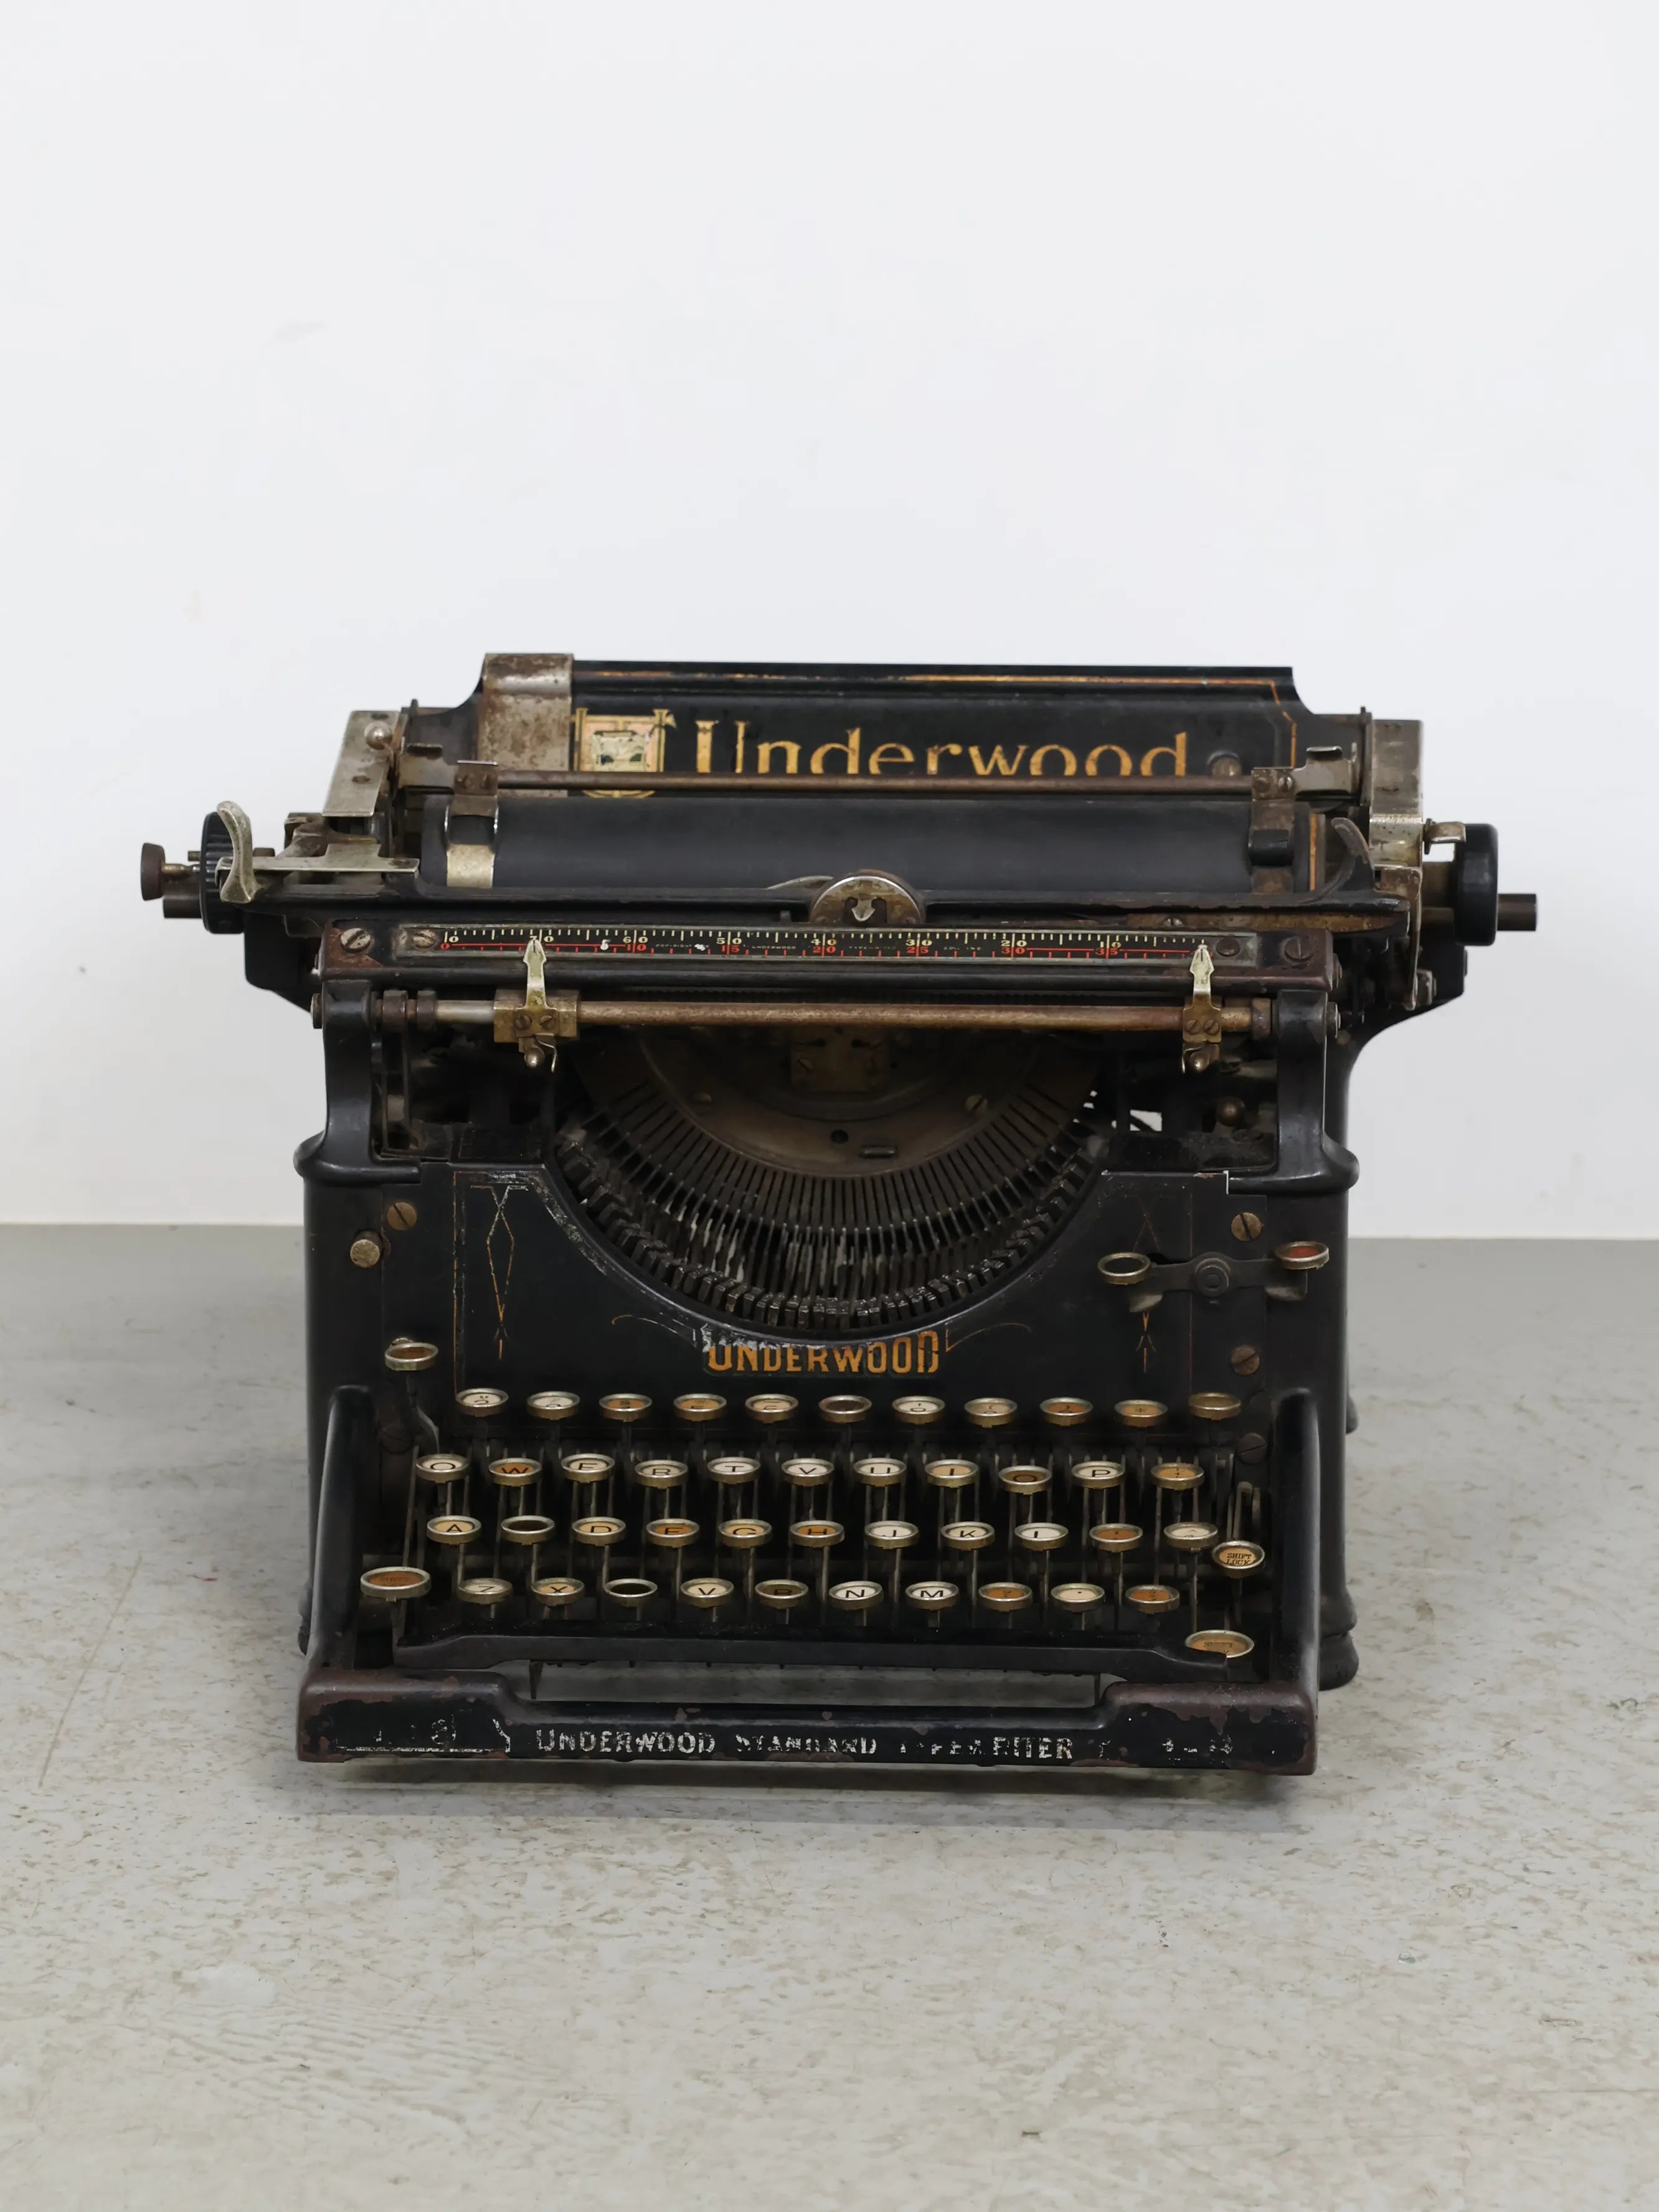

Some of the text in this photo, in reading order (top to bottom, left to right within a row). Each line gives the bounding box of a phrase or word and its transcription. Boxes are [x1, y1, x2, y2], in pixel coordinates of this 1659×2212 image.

[707, 1330, 939, 1374] UNDERWOOD
[1092, 1469, 1110, 1477] P
[446, 1524, 463, 1533] A
[845, 1589, 865, 1598] N
[536, 1729, 716, 1754] UNDERWOOD
